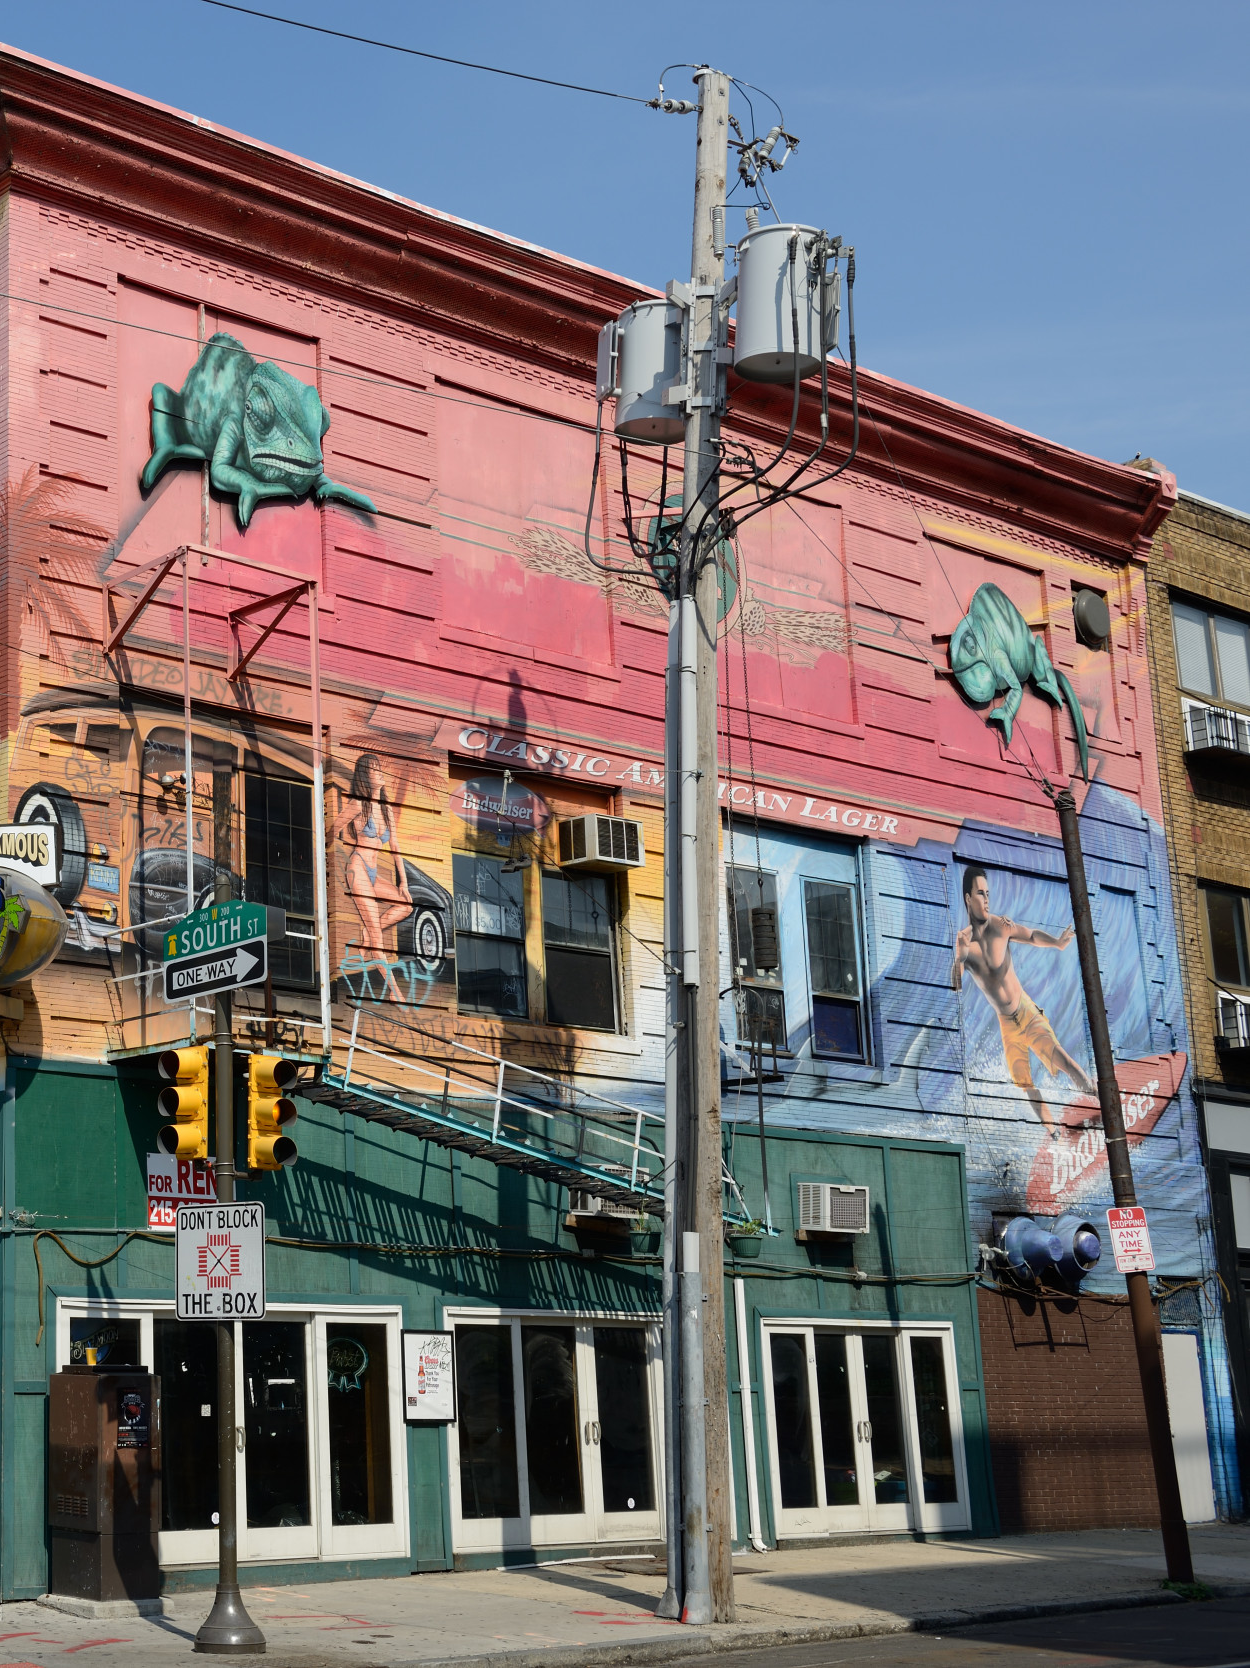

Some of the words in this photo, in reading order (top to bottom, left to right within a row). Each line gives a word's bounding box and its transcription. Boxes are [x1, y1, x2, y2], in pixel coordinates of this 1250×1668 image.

[458, 727, 611, 777] CLASSIC
[616, 761, 792, 813] AMICAN
[800, 797, 899, 835] LAGER
[461, 790, 534, 820] Budweiser
[211, 908, 218, 920] W
[181, 915, 241, 954] SOUTH
[247, 918, 259, 937] ST
[177, 967, 203, 987] ONE
[206, 958, 236, 979] WAY
[1047, 1079, 1160, 1195] Budwiser
[149, 1174, 173, 1193] FOR
[177, 1159, 218, 1196] REN
[181, 1209, 213, 1230] DON'T
[217, 1208, 259, 1229] BLOCK
[1111, 1219, 1145, 1228] STOPPING
[1119, 1209, 1134, 1220] NO
[1119, 1230, 1141, 1239] ANY
[1119, 1240, 1144, 1248] TIME
[182, 1293, 213, 1315] THE
[222, 1292, 258, 1314] BOX
